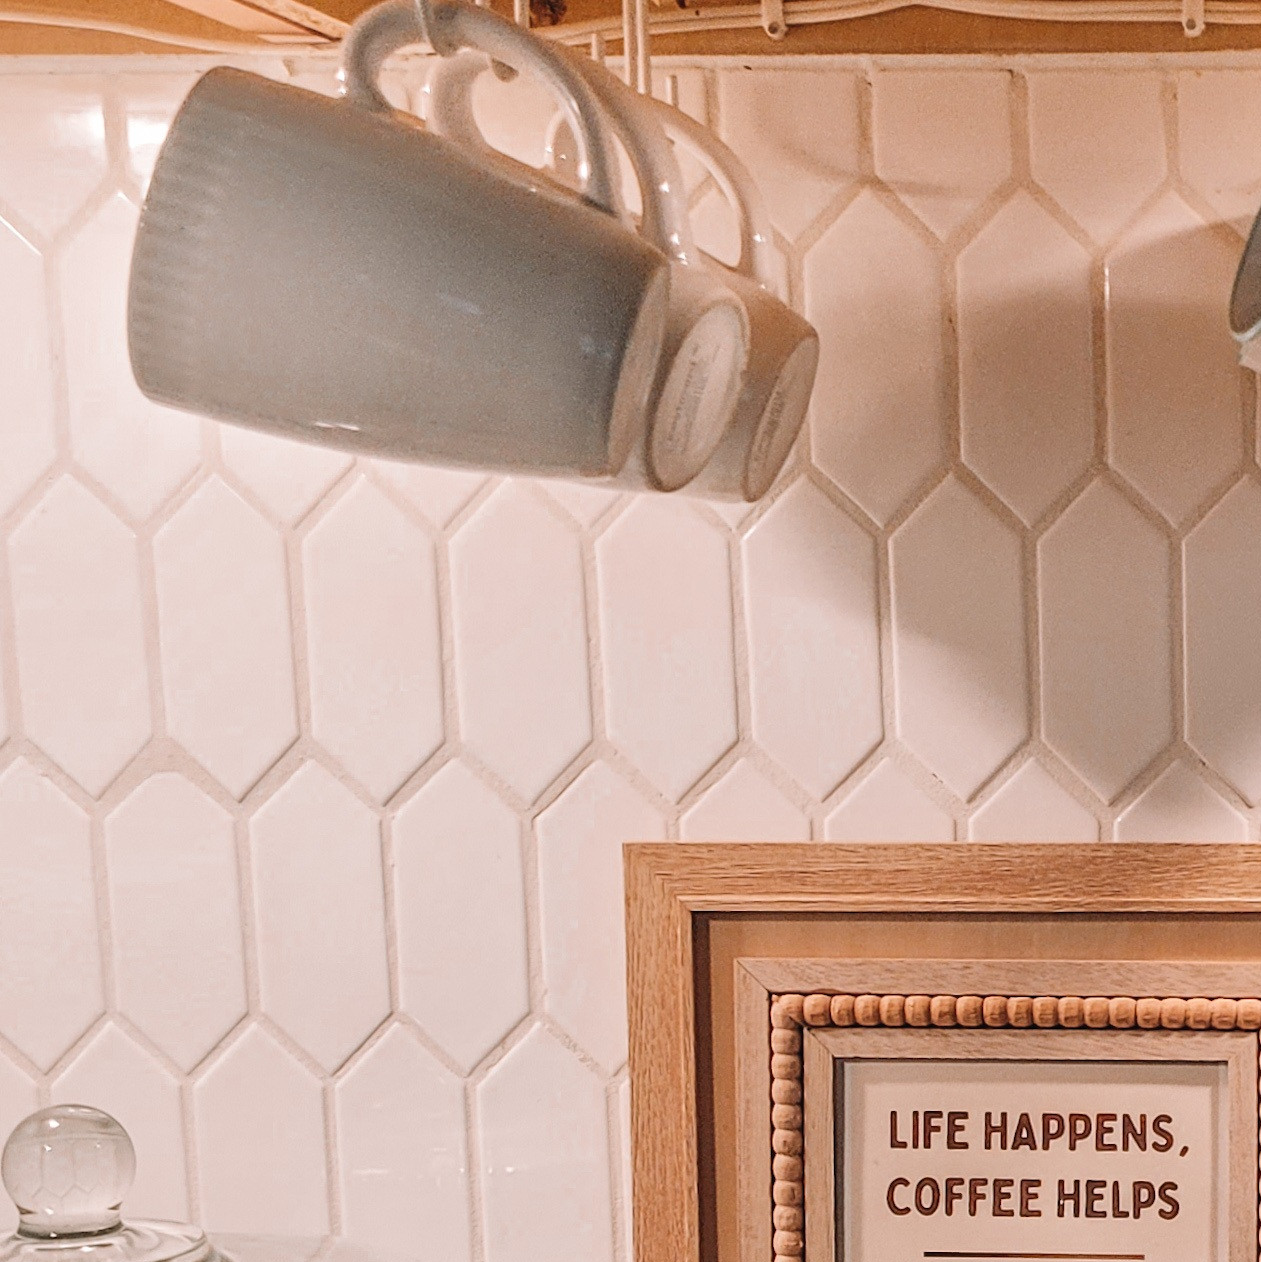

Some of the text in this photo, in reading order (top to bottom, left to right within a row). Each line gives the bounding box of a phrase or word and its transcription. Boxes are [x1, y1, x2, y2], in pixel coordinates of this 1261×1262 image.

[890, 1110, 1189, 1157] LIFE HAPPENS,
[886, 1177, 1180, 1220] COFFEE HELPS
